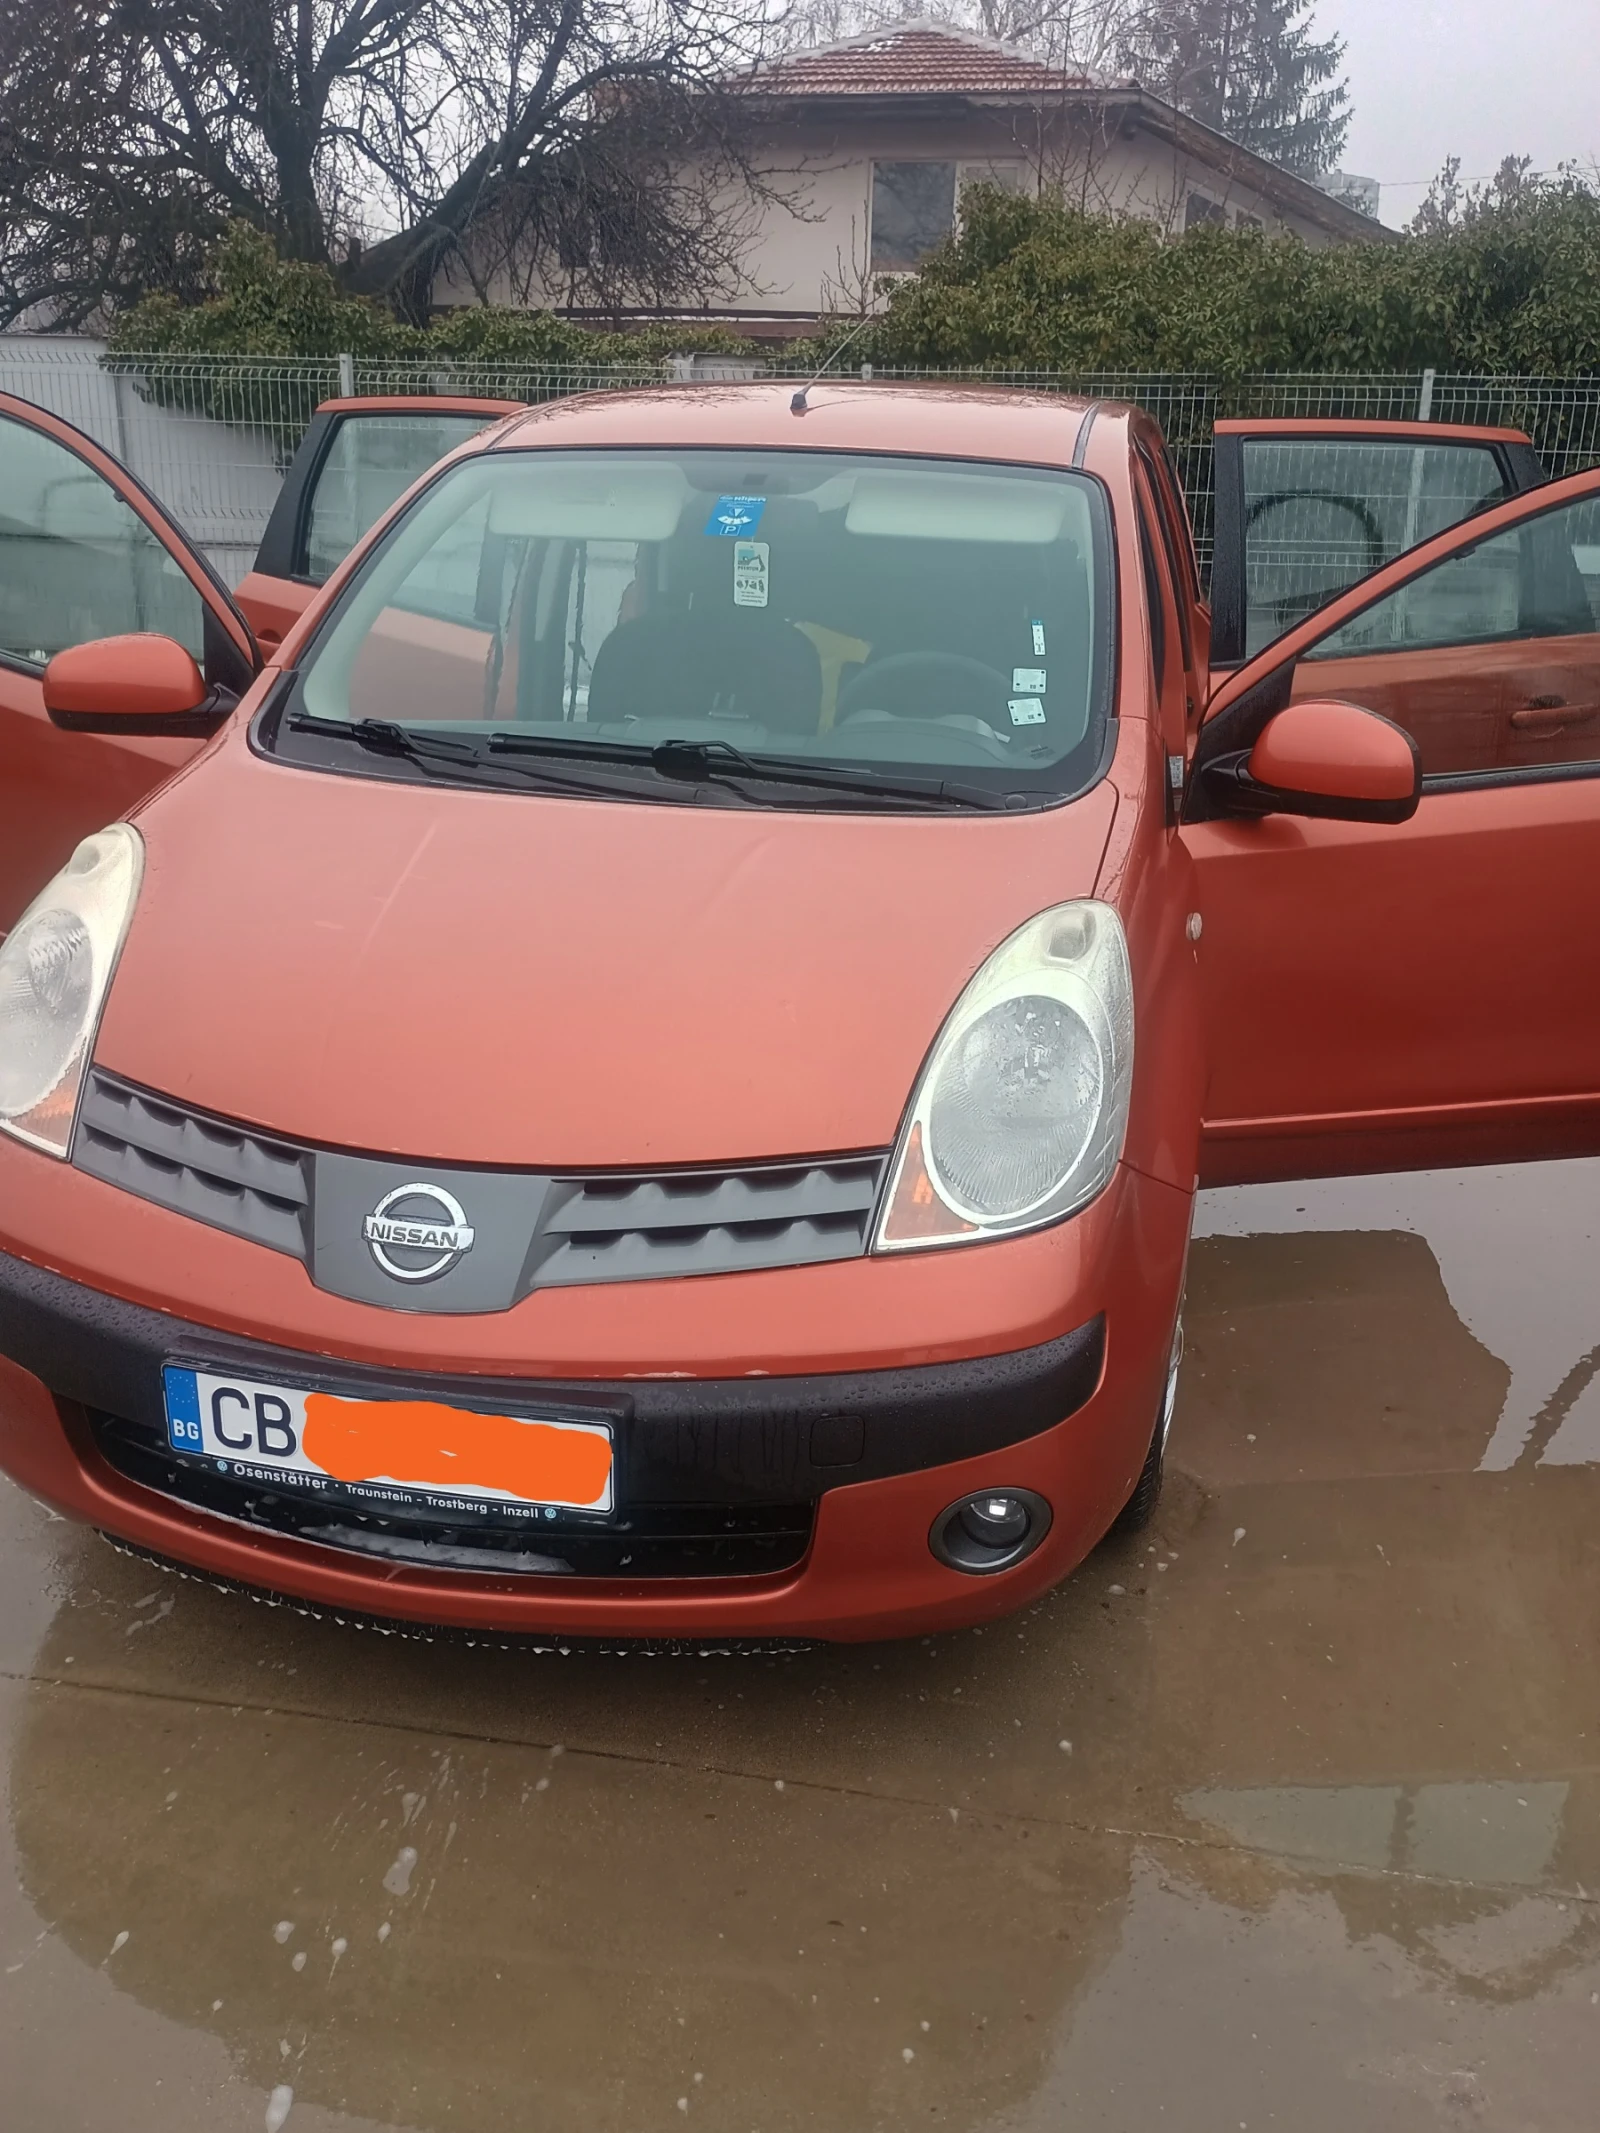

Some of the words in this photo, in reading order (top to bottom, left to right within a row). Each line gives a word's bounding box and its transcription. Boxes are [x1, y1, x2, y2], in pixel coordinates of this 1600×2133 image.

[724, 526, 736, 534] P
[370, 1222, 459, 1248] NISSAN
[173, 1418, 199, 1440] BG
[211, 1386, 298, 1458] CB
[233, 1463, 328, 1490] Osenstätter
[345, 1484, 412, 1503] Traunstein
[425, 1496, 488, 1515] Trostberg
[503, 1505, 539, 1519] Inzell
